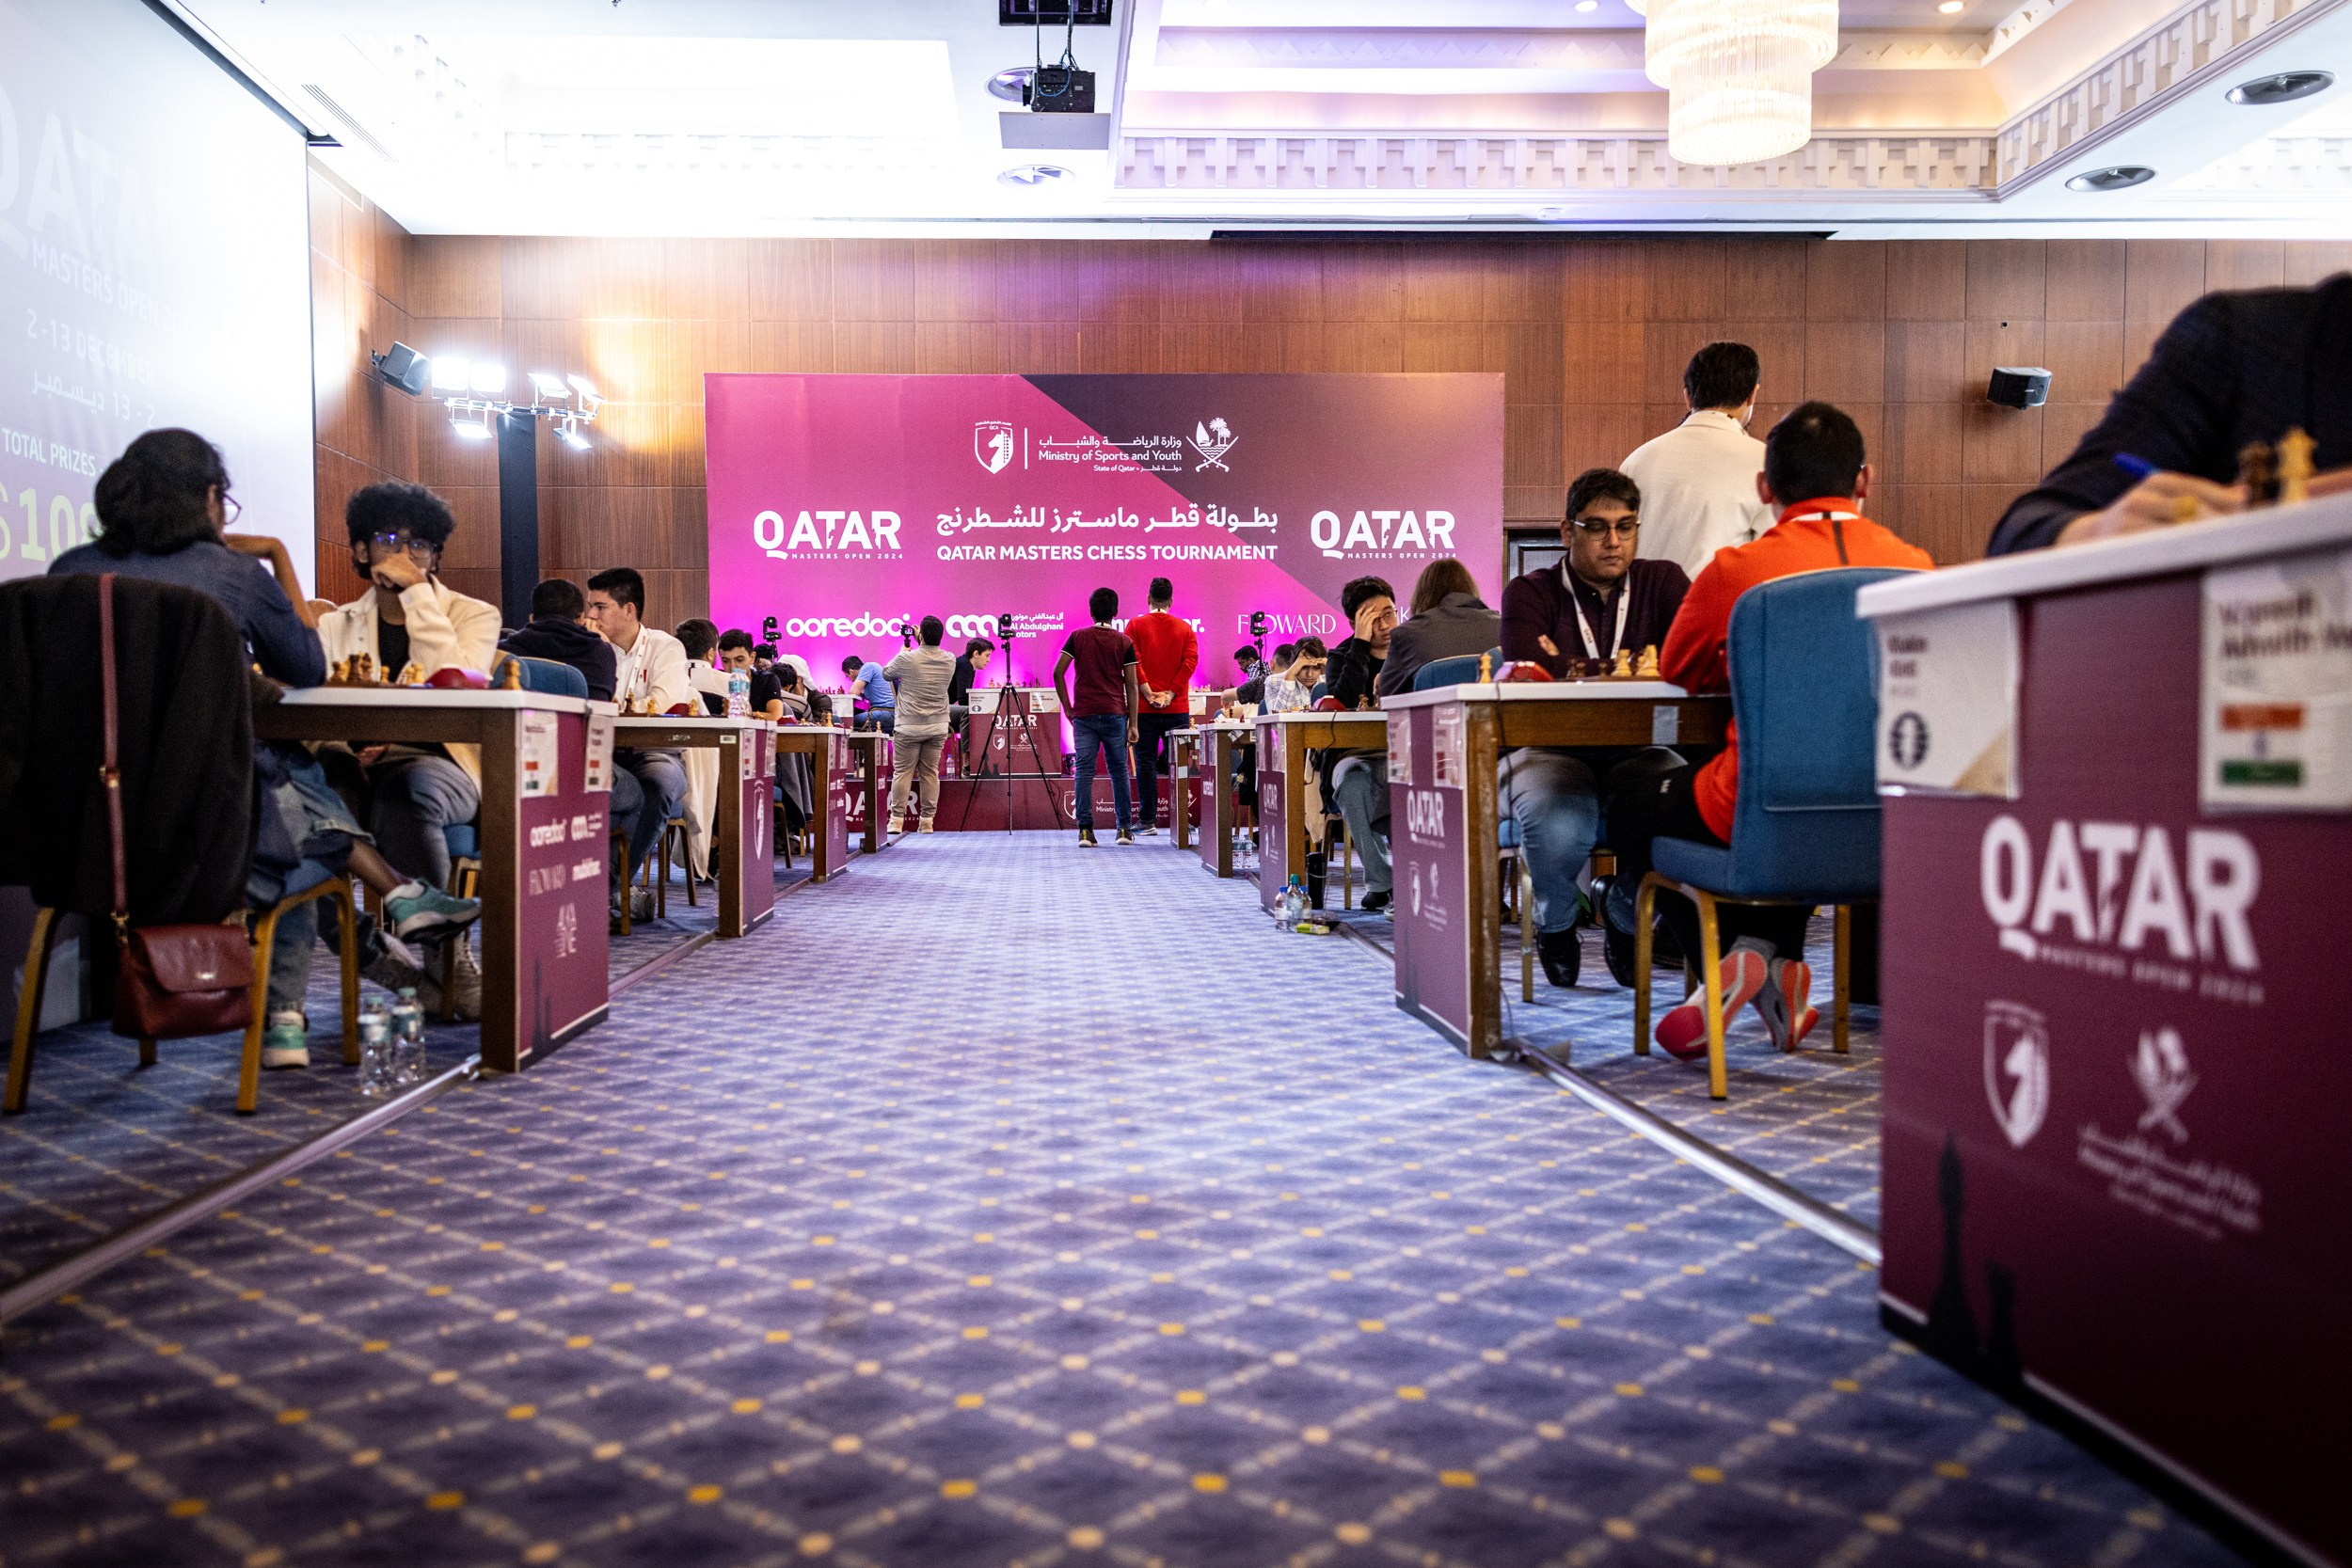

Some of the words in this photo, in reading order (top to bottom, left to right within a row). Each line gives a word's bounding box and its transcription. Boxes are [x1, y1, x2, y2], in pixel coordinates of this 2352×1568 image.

[32, 236, 113, 304] MASTERS
[75, 329, 155, 388] DECEMBER
[2, 427, 47, 465] TOTAL
[50, 442, 96, 478] PRIZES
[1038, 450, 1080, 463] Ministry
[1082, 450, 1093, 461] of
[1094, 450, 1130, 463] Sports
[1131, 450, 1150, 461] and
[1152, 450, 1183, 461] Youth
[1039, 435, 1100, 449] والشباب
[1102, 435, 1159, 449] الرياضة
[1161, 435, 1183, 449] وزارة
[936, 503, 1045, 537] للشطرنج
[1050, 506, 1139, 533] ماسترز
[1143, 502, 1200, 533] قطر
[1205, 503, 1279, 533] بطولة
[754, 510, 901, 560] QATAR
[1310, 510, 1455, 560] QATAR
[936, 546, 996, 561] QATAR
[999, 546, 1083, 560] MASTERS
[1087, 546, 1147, 560] CHESS
[1150, 546, 1279, 560] TOURNAMENT
[1019, 623, 1064, 631] Abdulghani
[1237, 614, 1337, 635] FOWARD
[1406, 790, 1445, 841] QATAR
[1980, 816, 2263, 972] QATAR
